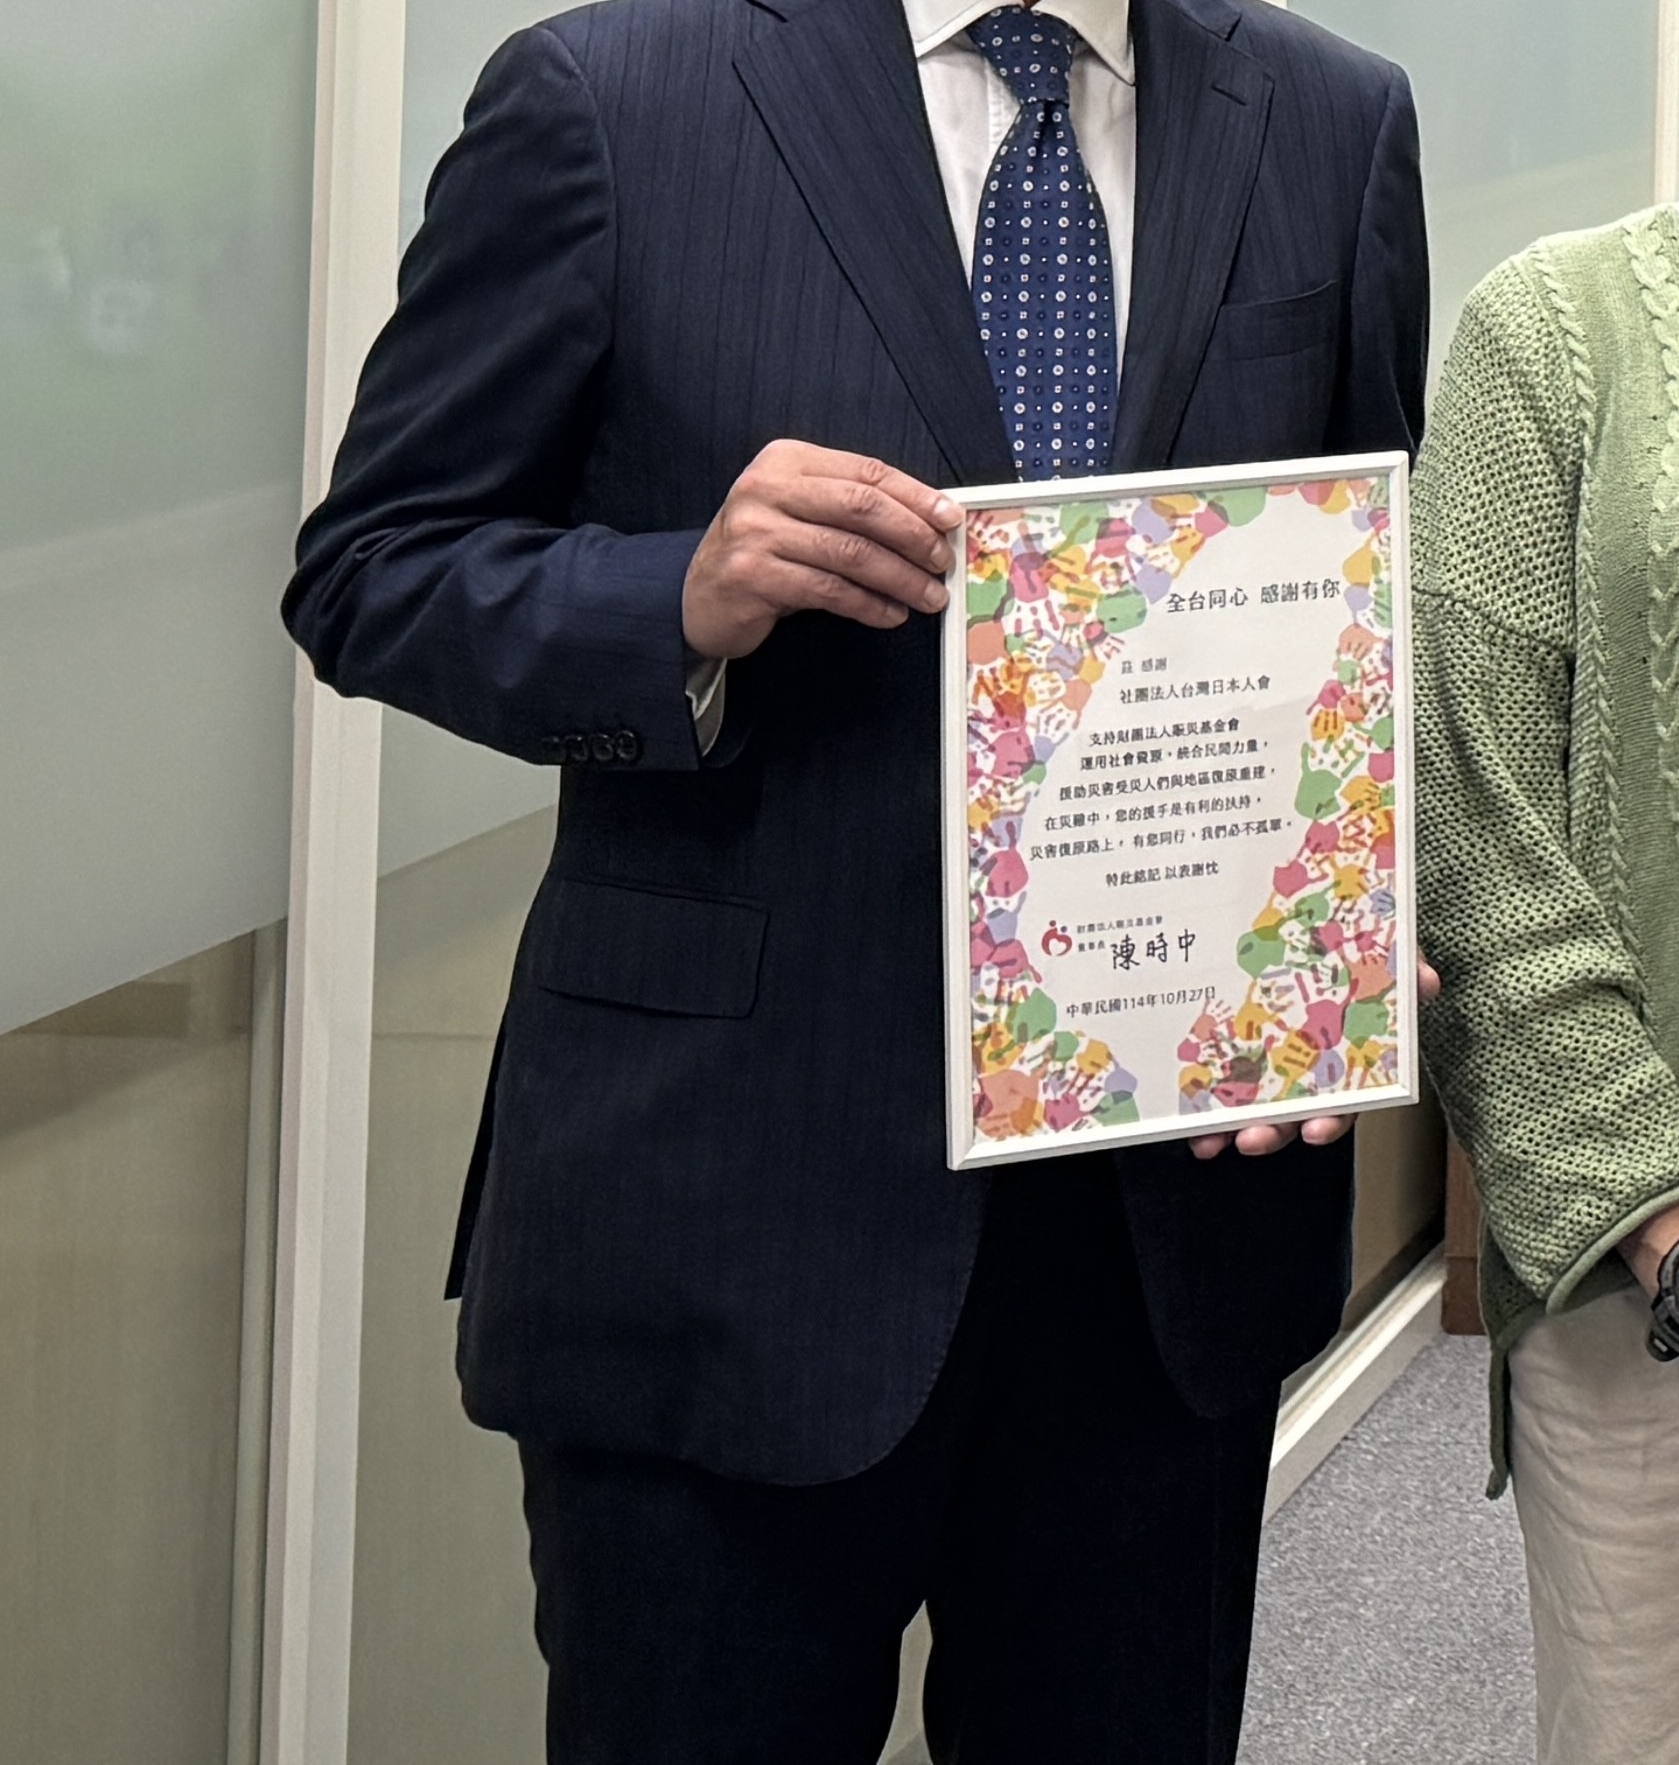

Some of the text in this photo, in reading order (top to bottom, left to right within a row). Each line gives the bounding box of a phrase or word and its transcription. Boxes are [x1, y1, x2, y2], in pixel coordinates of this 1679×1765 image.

[1165, 578, 1341, 614] 全台同心 感謝有你
